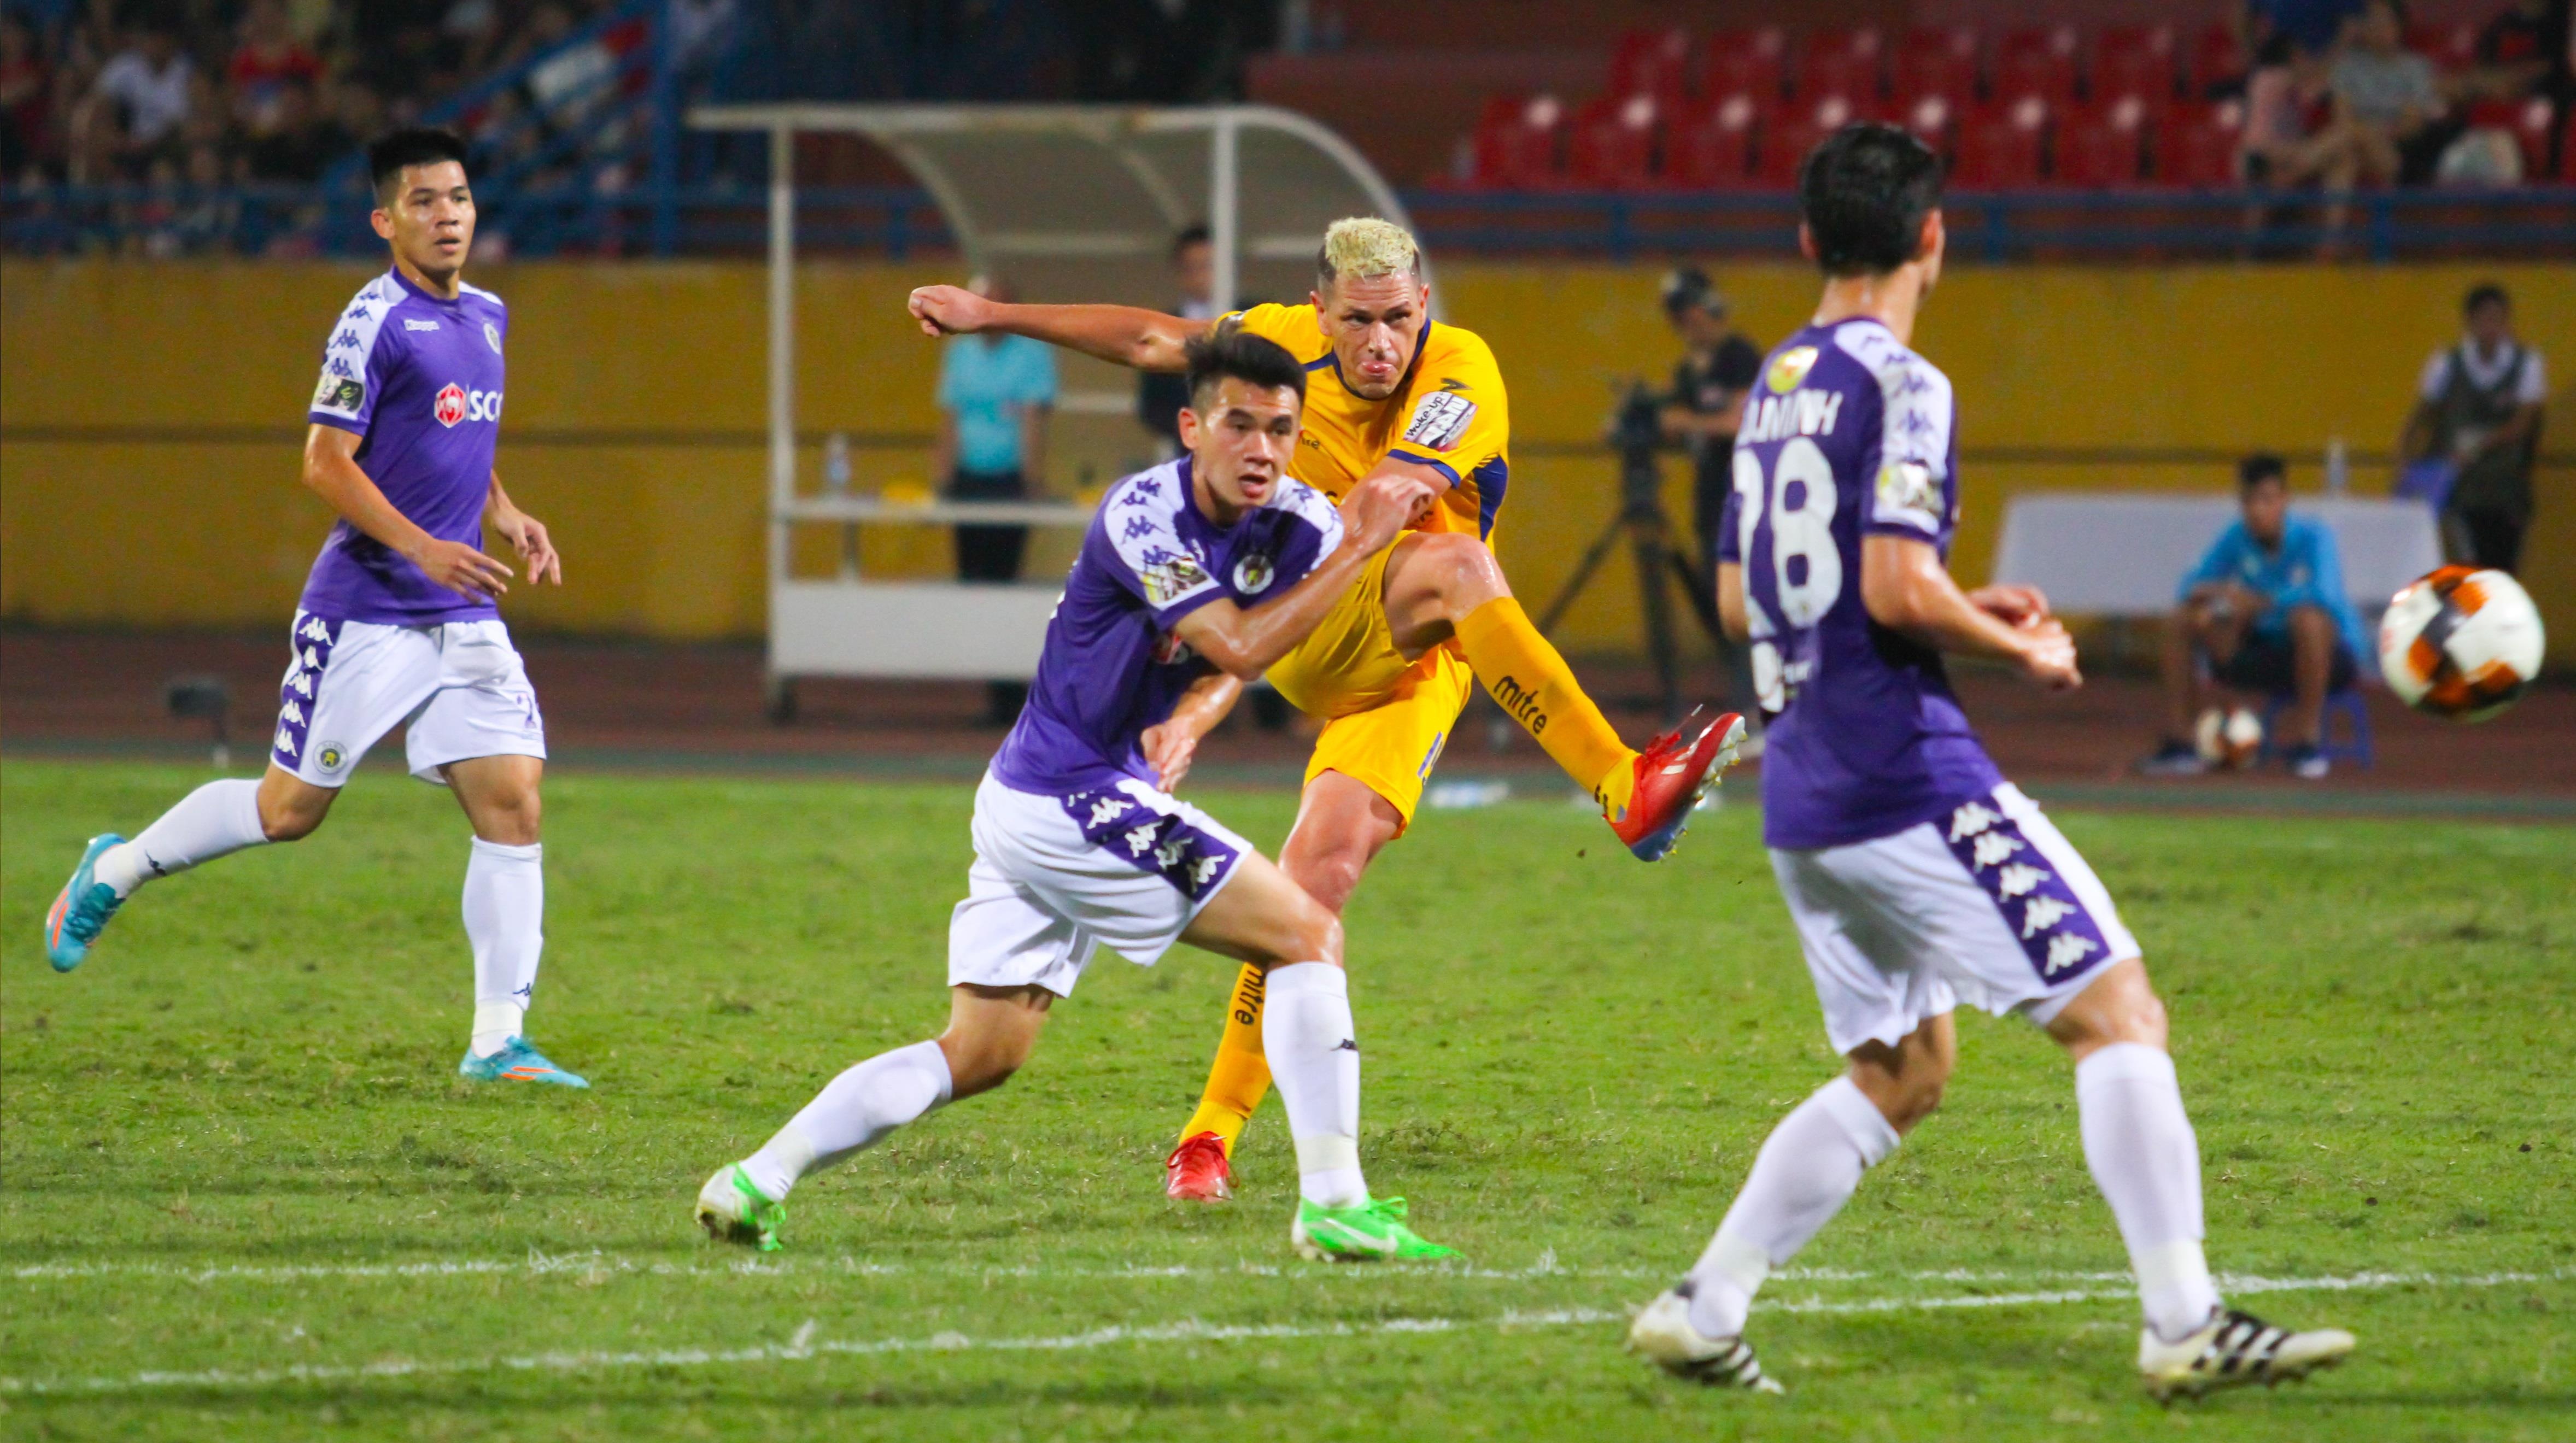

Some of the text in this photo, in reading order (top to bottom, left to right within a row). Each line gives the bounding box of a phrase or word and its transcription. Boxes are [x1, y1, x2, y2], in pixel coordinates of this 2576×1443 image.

[1407, 396, 1444, 436] Wake-up
[1494, 676, 1547, 735] mitre
[1234, 970, 1267, 1026] mitre
